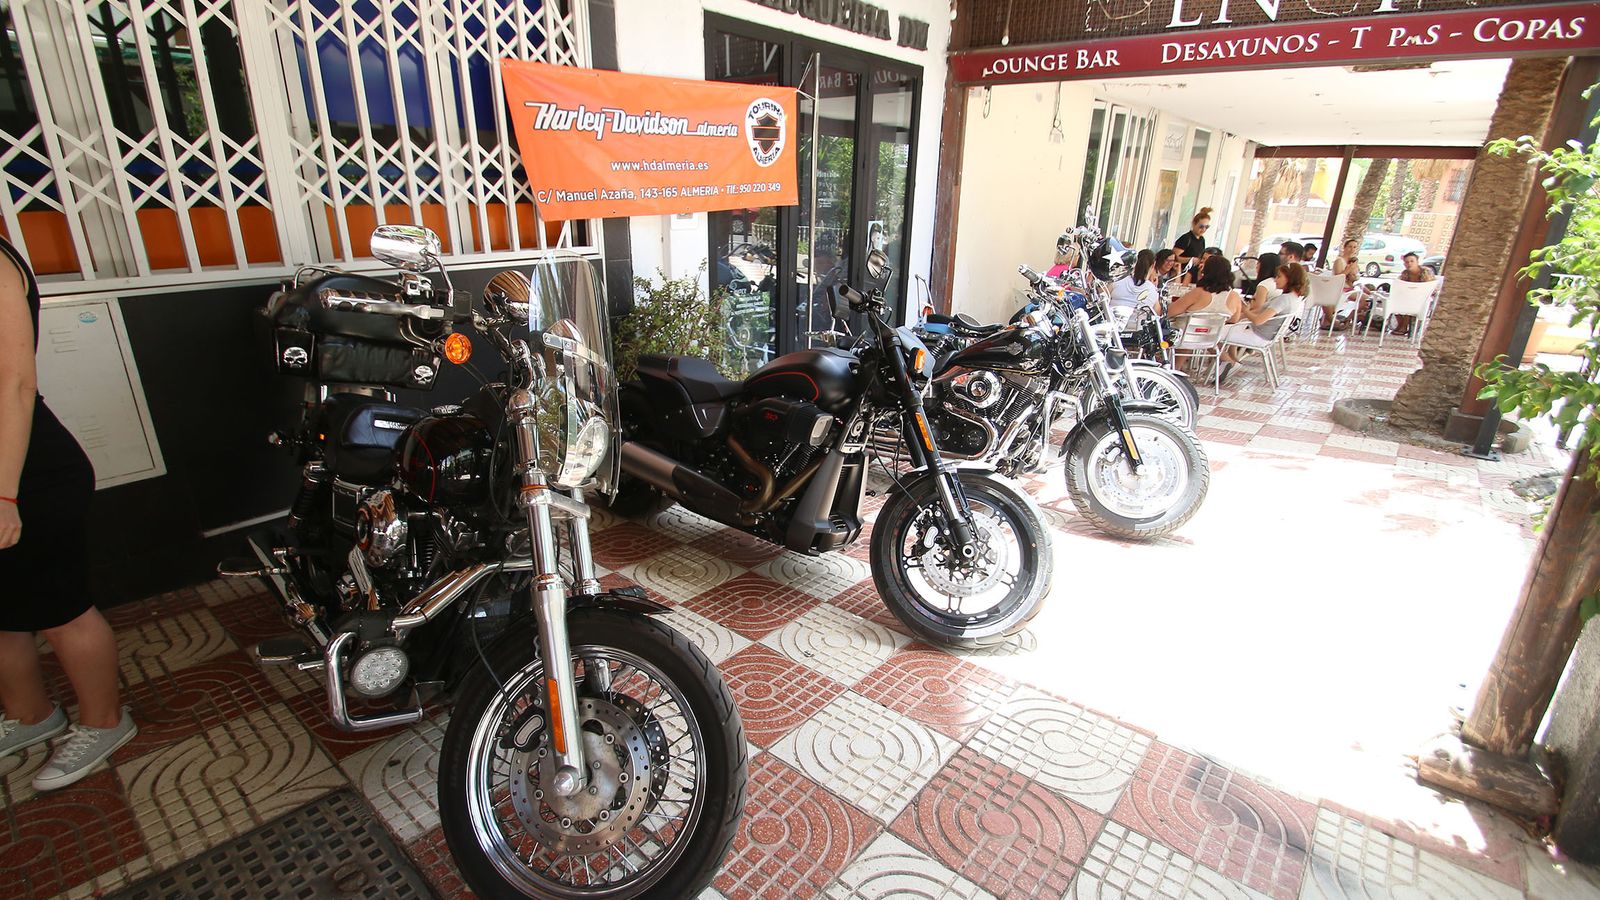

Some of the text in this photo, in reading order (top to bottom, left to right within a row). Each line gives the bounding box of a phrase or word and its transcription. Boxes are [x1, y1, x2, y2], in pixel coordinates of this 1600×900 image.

[1161, 33, 1320, 64] DESAYUNOS
[1473, 16, 1586, 43] COPAS
[1075, 49, 1121, 71] BAR
[523, 101, 690, 141] Harley-Davidson
[610, 159, 709, 171] www.hdalmeria.es
[537, 190, 552, 204] C/
[556, 189, 598, 202] Manuel
[600, 188, 637, 201] Azaña,
[640, 187, 678, 198] 143-165
[680, 185, 719, 197] ALMERIA
[740, 184, 751, 193] 950
[753, 183, 766, 193] 220
[767, 182, 781, 192] 349
